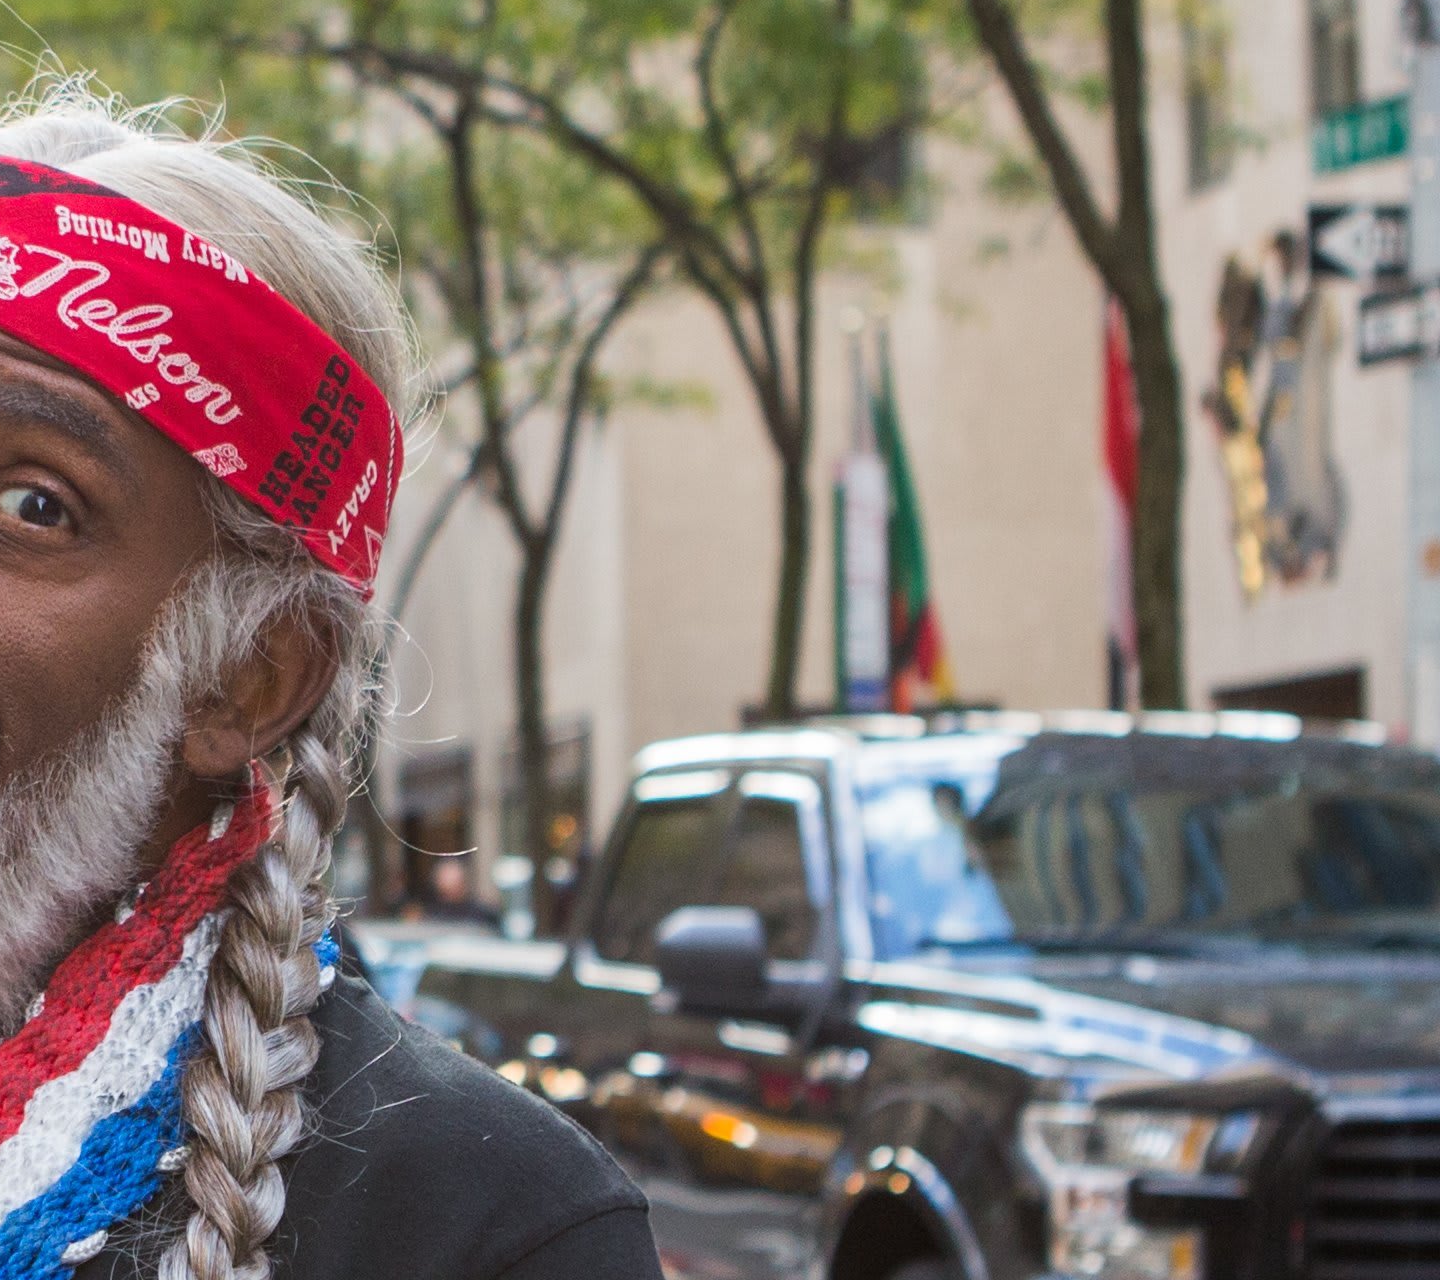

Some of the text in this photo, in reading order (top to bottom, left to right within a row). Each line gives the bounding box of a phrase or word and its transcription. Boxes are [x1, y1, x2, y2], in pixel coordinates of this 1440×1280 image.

[54, 205, 249, 284] Mary Morning
[19, 243, 243, 425] Nelson
[258, 354, 351, 507] HEADED
[327, 459, 378, 556] CRAZY
